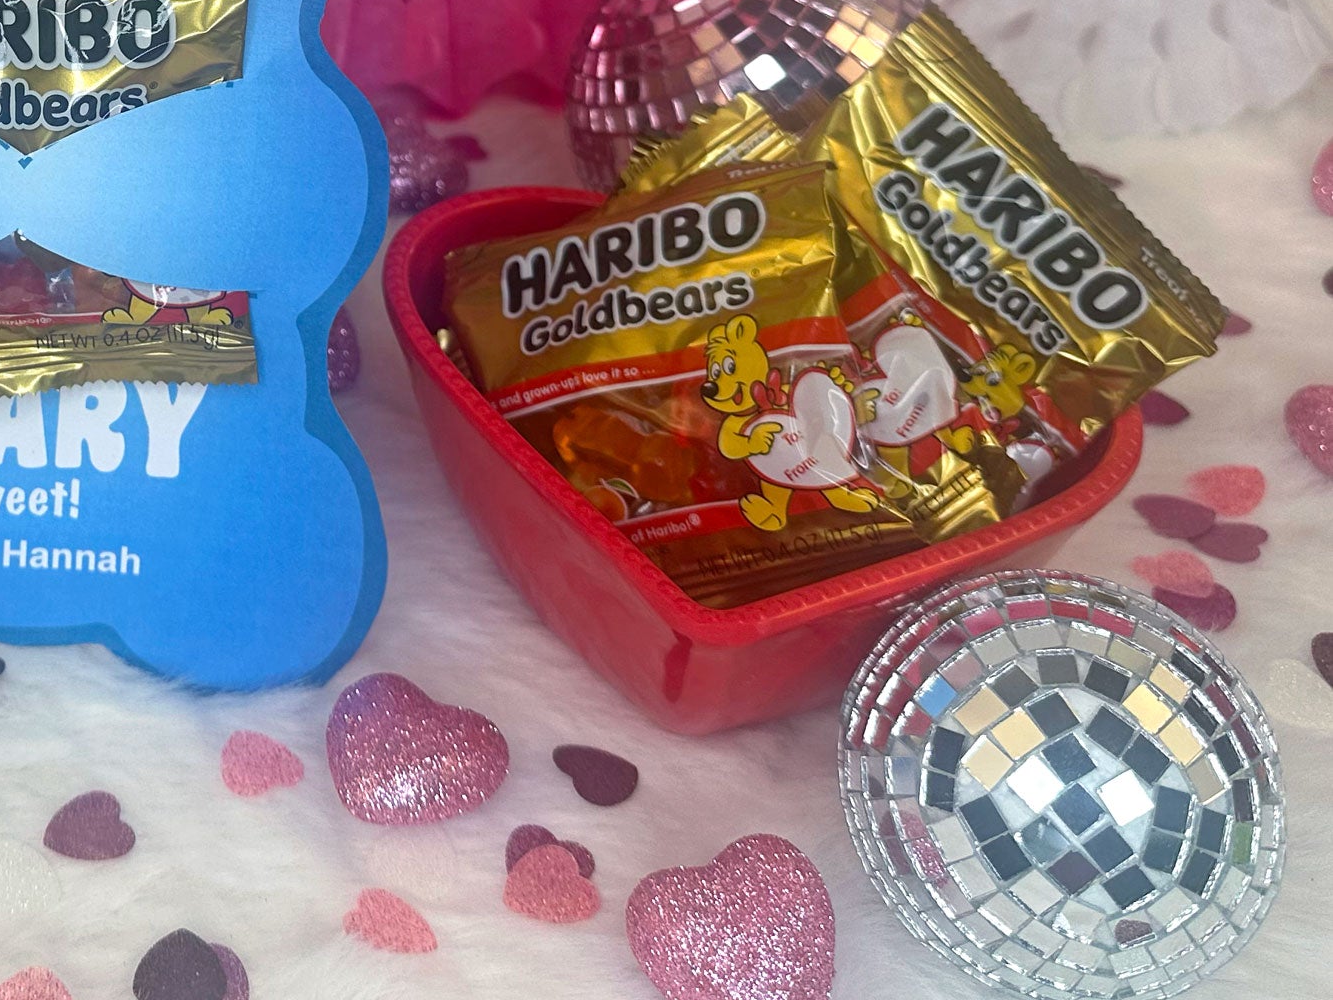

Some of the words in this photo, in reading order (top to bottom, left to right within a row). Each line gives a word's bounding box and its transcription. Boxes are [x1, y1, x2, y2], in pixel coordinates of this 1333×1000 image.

[896, 104, 1145, 328] HARIBO
[503, 193, 764, 316] HARIBO
[874, 171, 1067, 354] Goldbears
[70, 334, 97, 349] WT
[103, 330, 130, 347] 0.4
[135, 327, 162, 343] OZ
[521, 275, 752, 356] Goldbears
[499, 393, 524, 408] and
[523, 376, 580, 404] grown-ups
[582, 371, 609, 384] love
[611, 368, 619, 379] it
[623, 367, 639, 378] so
[2, 540, 141, 576] Hannah
[630, 528, 645, 543] of
